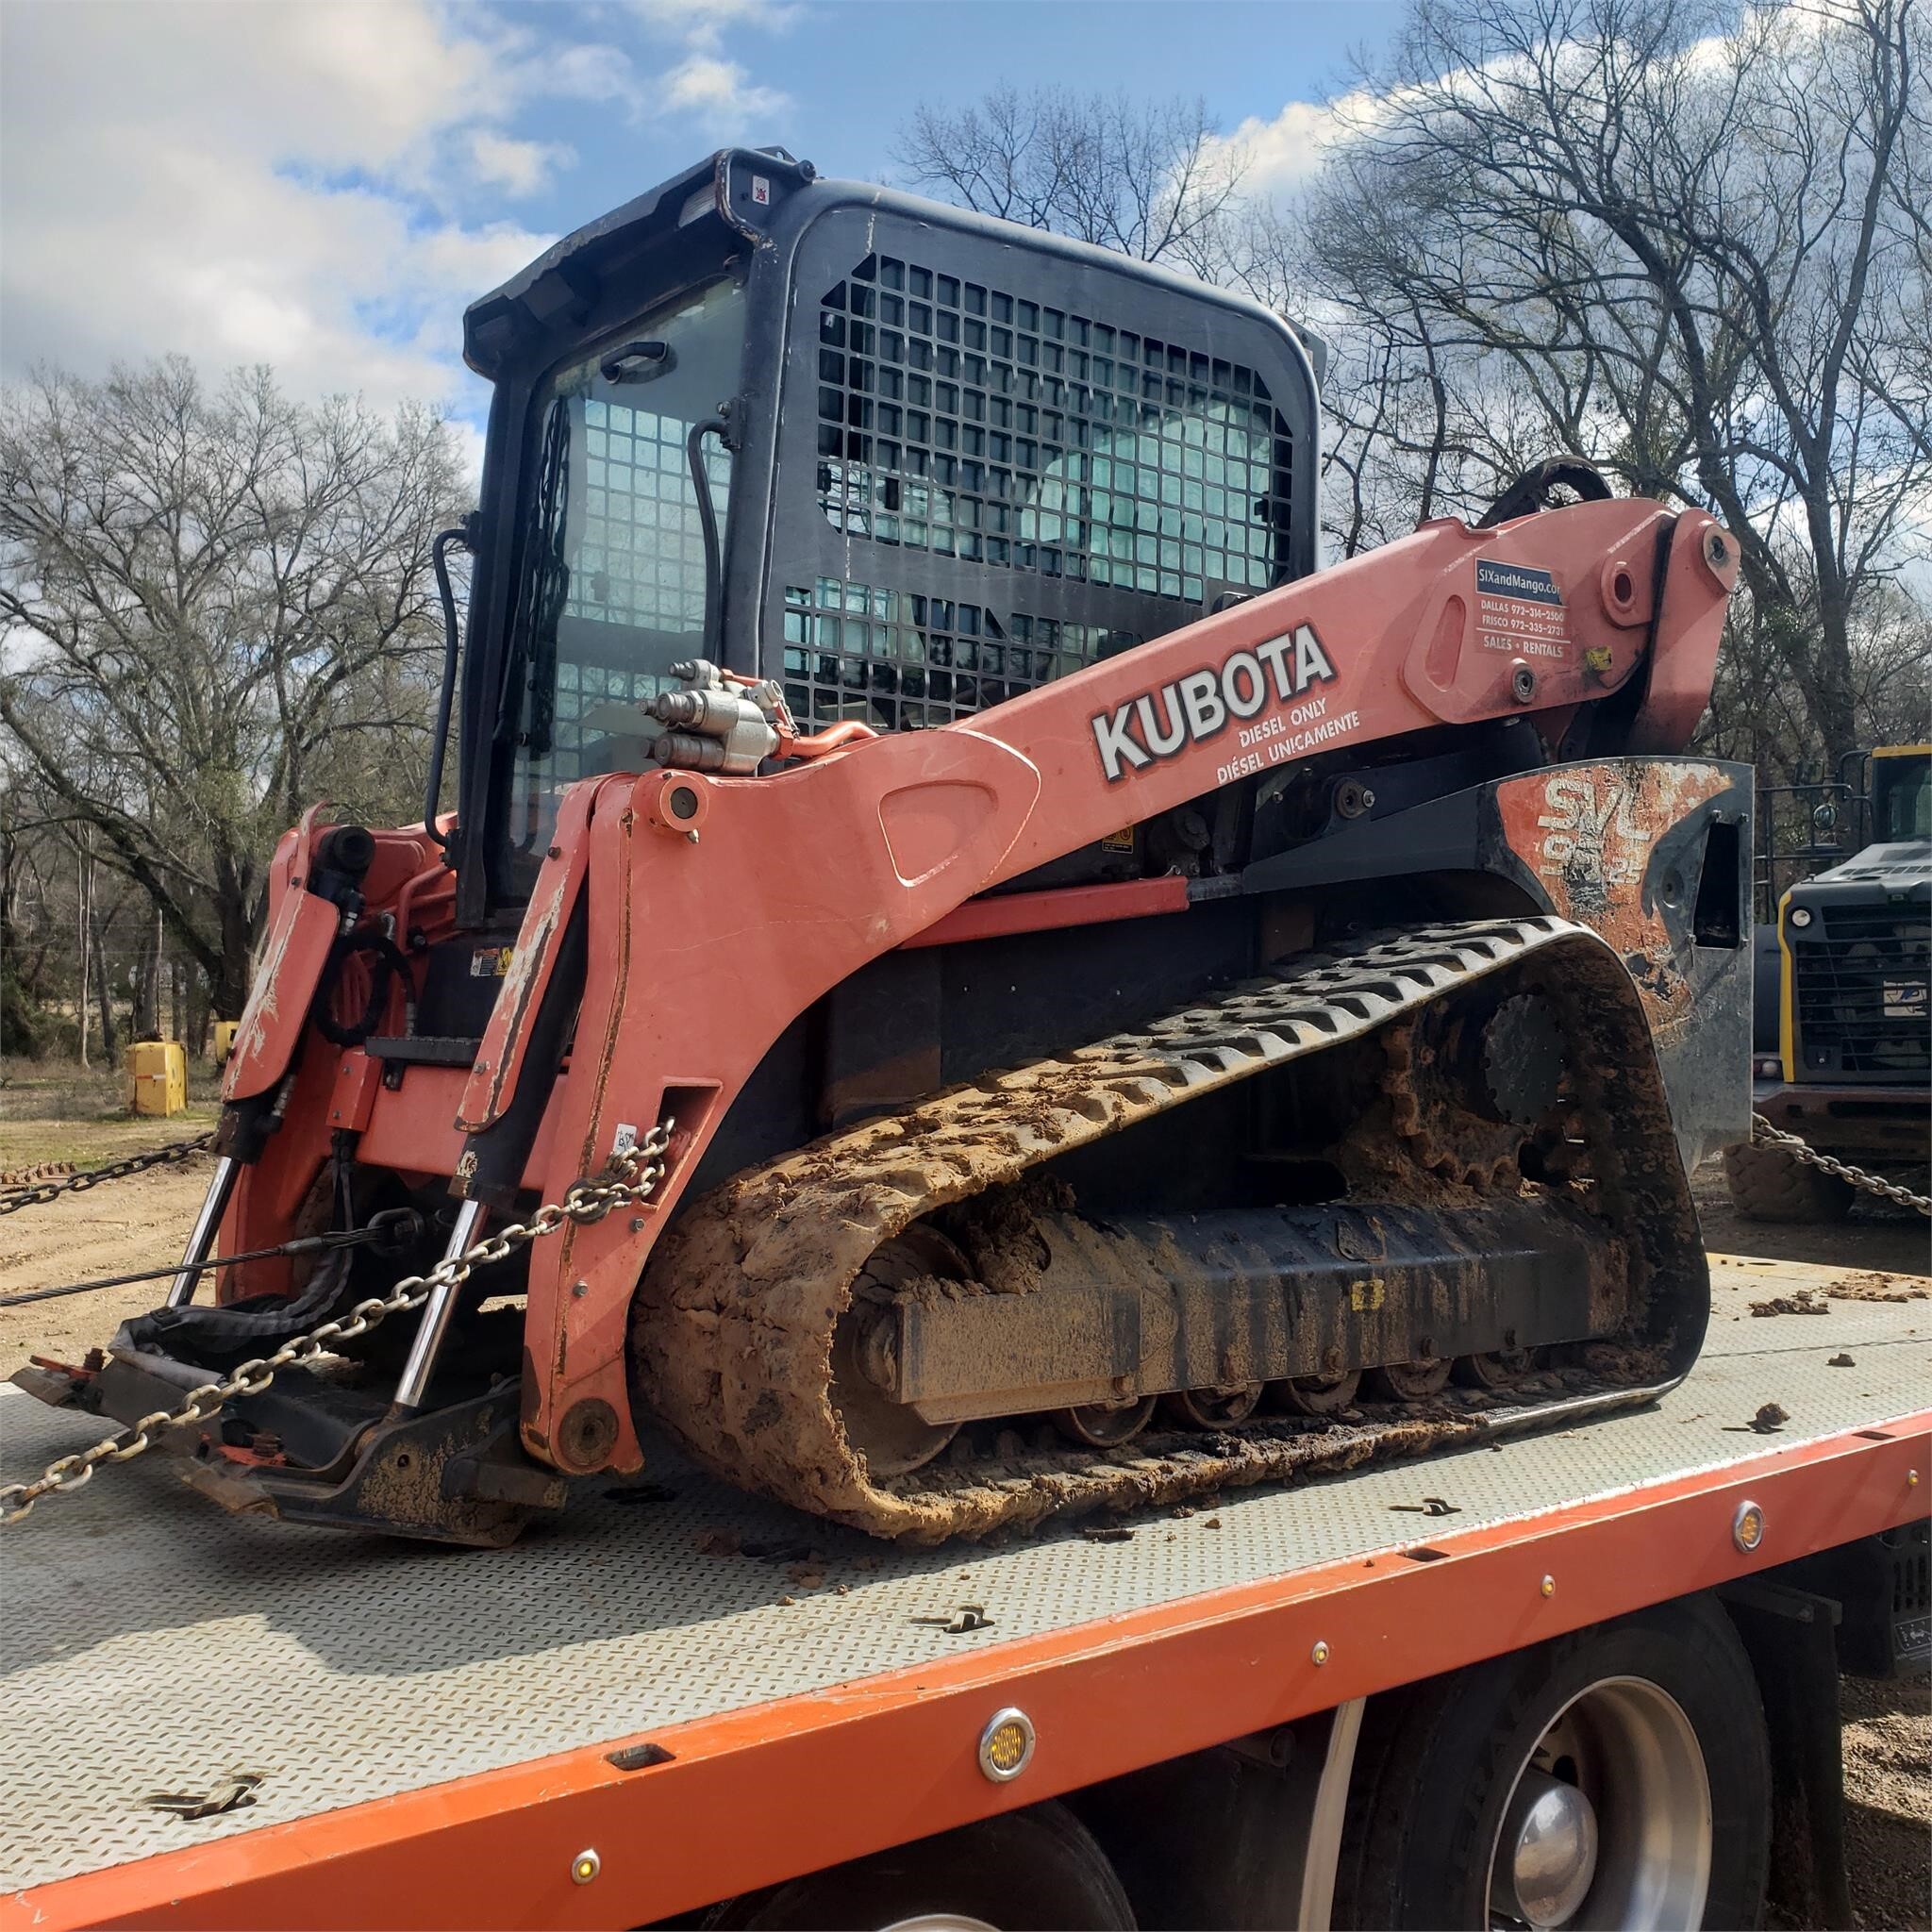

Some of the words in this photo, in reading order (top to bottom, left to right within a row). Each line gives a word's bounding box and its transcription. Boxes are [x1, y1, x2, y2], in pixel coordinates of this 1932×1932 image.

[1480, 599, 1509, 613] DALLAS
[1511, 604, 1565, 623] 972-314-2500
[1482, 614, 1508, 627] FRISCO
[1510, 619, 1564, 637] 972-335-2731
[1483, 635, 1513, 650] SALES
[1523, 641, 1563, 658] RENTALS
[1091, 624, 1335, 782] KUBOTA
[1239, 718, 1287, 748] DIESEL
[1291, 697, 1327, 724] ONLY
[1216, 756, 1264, 785] DIÉSEL
[1268, 710, 1360, 763] UNICAMENTE
